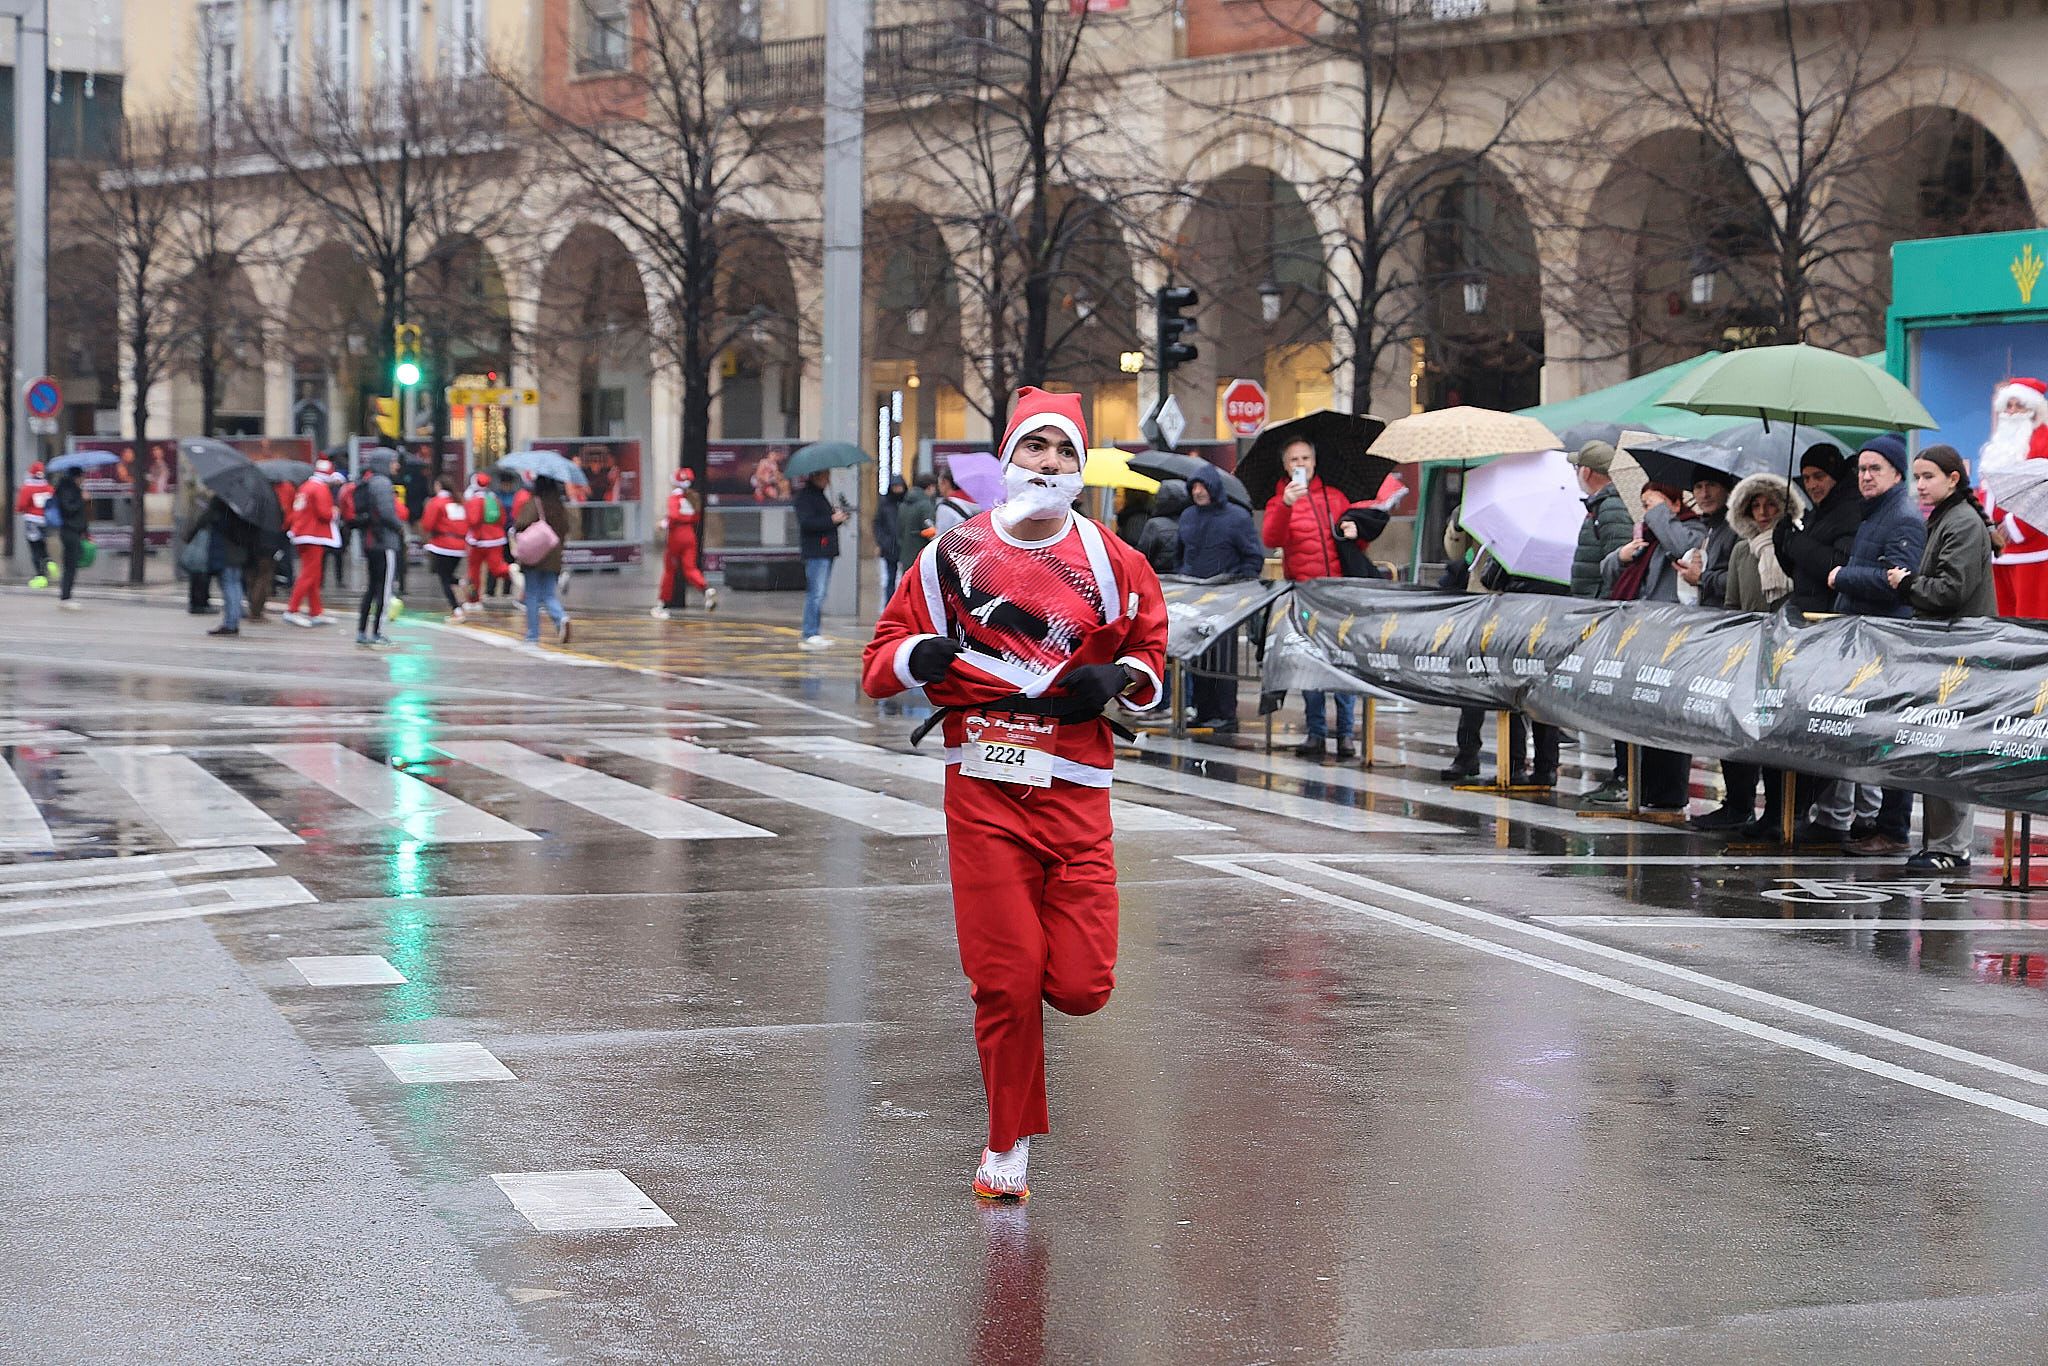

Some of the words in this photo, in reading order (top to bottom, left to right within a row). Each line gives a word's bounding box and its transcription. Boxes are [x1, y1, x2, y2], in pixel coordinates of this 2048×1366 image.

[1229, 400, 1264, 416] STOP
[1808, 693, 1836, 714] CAJA
[1832, 697, 1868, 718] RURAL
[1807, 718, 1820, 733] DE
[1819, 718, 1854, 737] ARAGÓN
[1923, 708, 1964, 730] RURAL
[1895, 729, 1909, 744] DE
[1908, 730, 1946, 748] ARAGÓN
[985, 744, 1025, 766] 2224
[1988, 740, 2003, 755] DE
[2001, 740, 2043, 761] ARAGÓN
